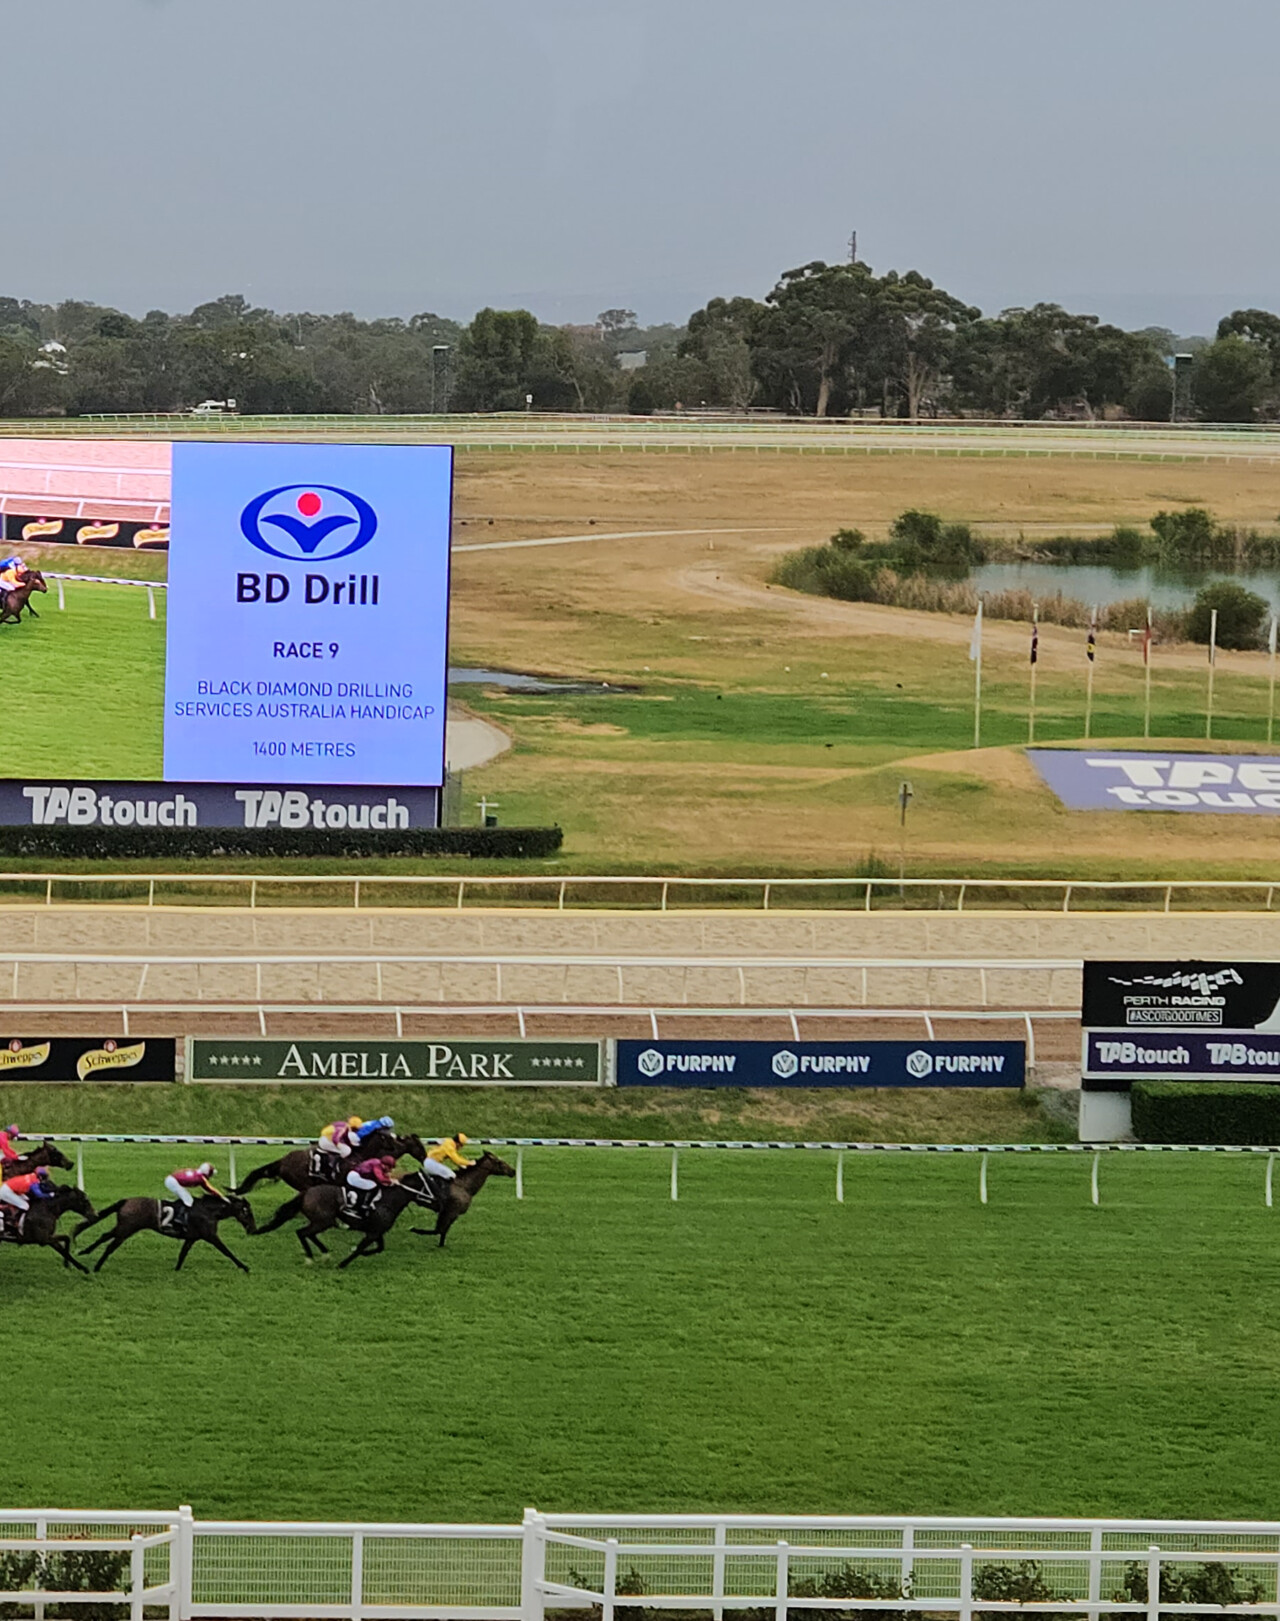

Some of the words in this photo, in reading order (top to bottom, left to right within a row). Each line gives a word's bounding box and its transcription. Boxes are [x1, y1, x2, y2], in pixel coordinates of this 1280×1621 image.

[236, 573, 290, 604] BD
[304, 574, 379, 606] Drill
[273, 642, 324, 659] RACE
[328, 642, 340, 659] 9
[197, 680, 252, 696] BLACK
[256, 681, 333, 697] DIAMOND
[337, 682, 413, 698] DRILLING
[174, 702, 253, 718] SERVICES
[256, 703, 347, 720] AUSTRALIA
[350, 705, 435, 721] HANDICAP
[253, 742, 287, 757] 1400
[291, 742, 356, 758] METRES
[22, 786, 198, 827] TABtouch
[234, 790, 410, 830] TABtouch
[1123, 996, 1169, 1006] PERTH
[1171, 996, 1226, 1006] RACING
[1129, 1010, 1220, 1022] #ASCOTGOODTIMES
[277, 1043, 412, 1077] AMELIA
[426, 1044, 514, 1078] PARK
[1095, 1042, 1190, 1065] TABtouch
[666, 1054, 736, 1073] FURPHY
[800, 1055, 871, 1073] FURPHY
[935, 1055, 1005, 1073] FURPHY
[161, 1206, 174, 1227] 2
